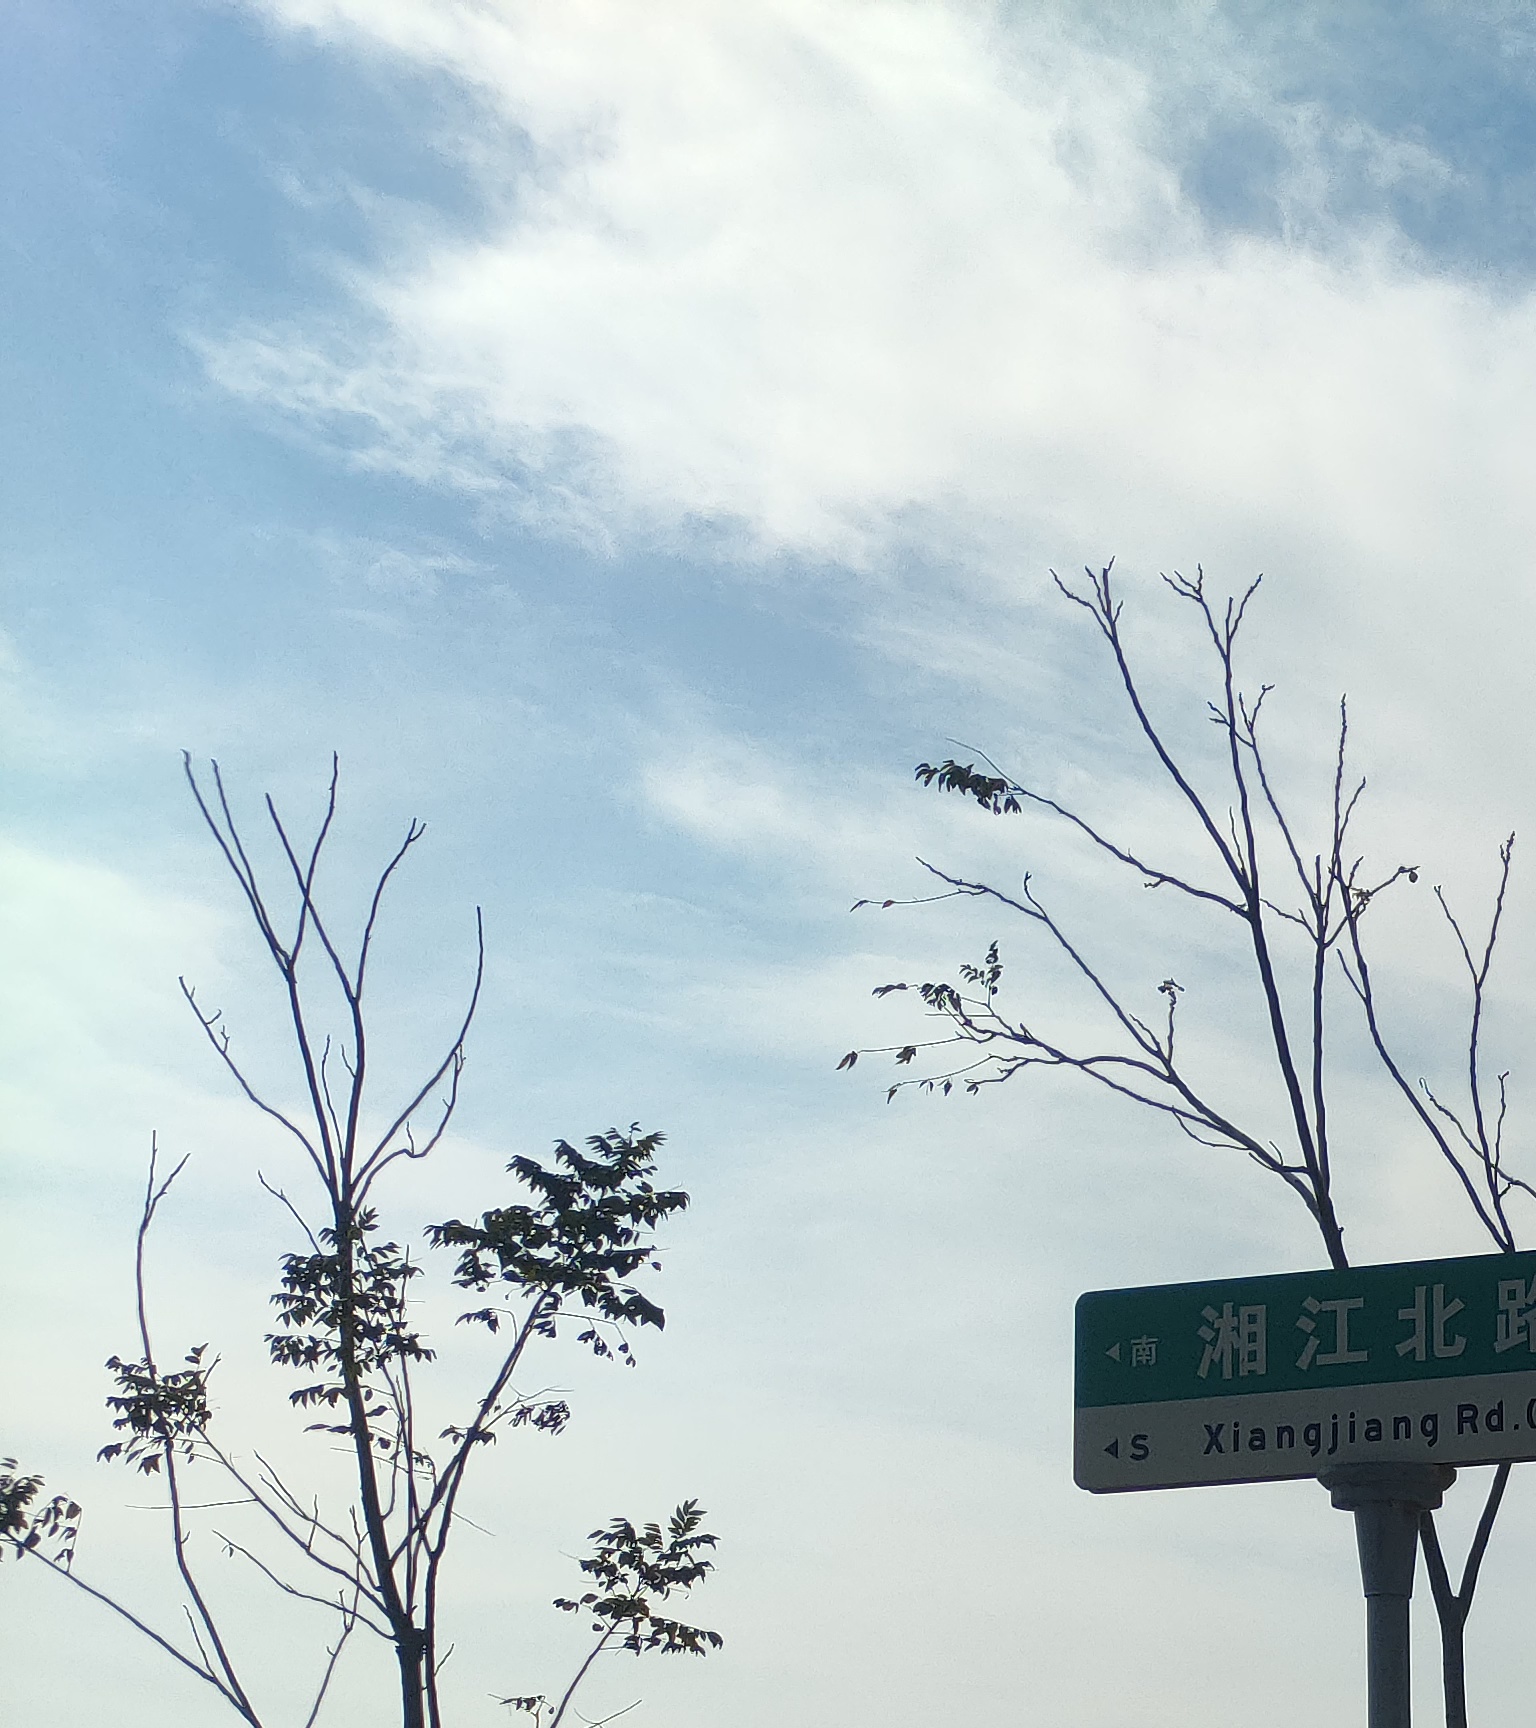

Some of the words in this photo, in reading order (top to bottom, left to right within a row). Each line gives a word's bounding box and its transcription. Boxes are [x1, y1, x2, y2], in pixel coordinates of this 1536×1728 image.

[1130, 1334, 1159, 1368] 南
[1129, 1433, 1150, 1462] S
[1203, 1411, 1439, 1457] Xiangjiang
